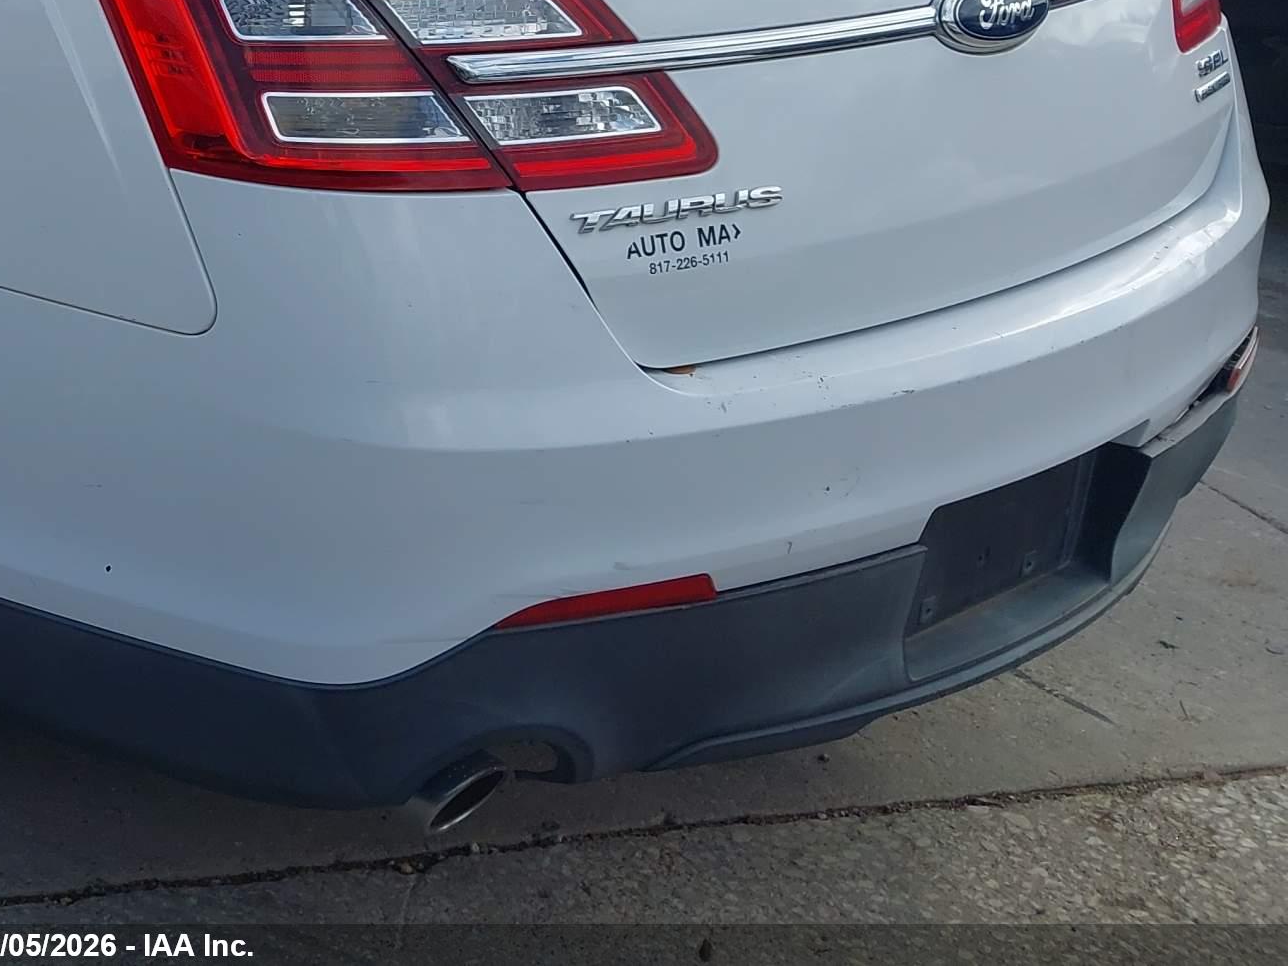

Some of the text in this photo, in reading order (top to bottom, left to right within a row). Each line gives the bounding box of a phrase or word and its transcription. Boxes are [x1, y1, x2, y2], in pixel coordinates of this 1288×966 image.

[569, 185, 784, 234] TAURUS
[626, 230, 686, 260] AUTO
[649, 250, 730, 275] 817-226-5111
